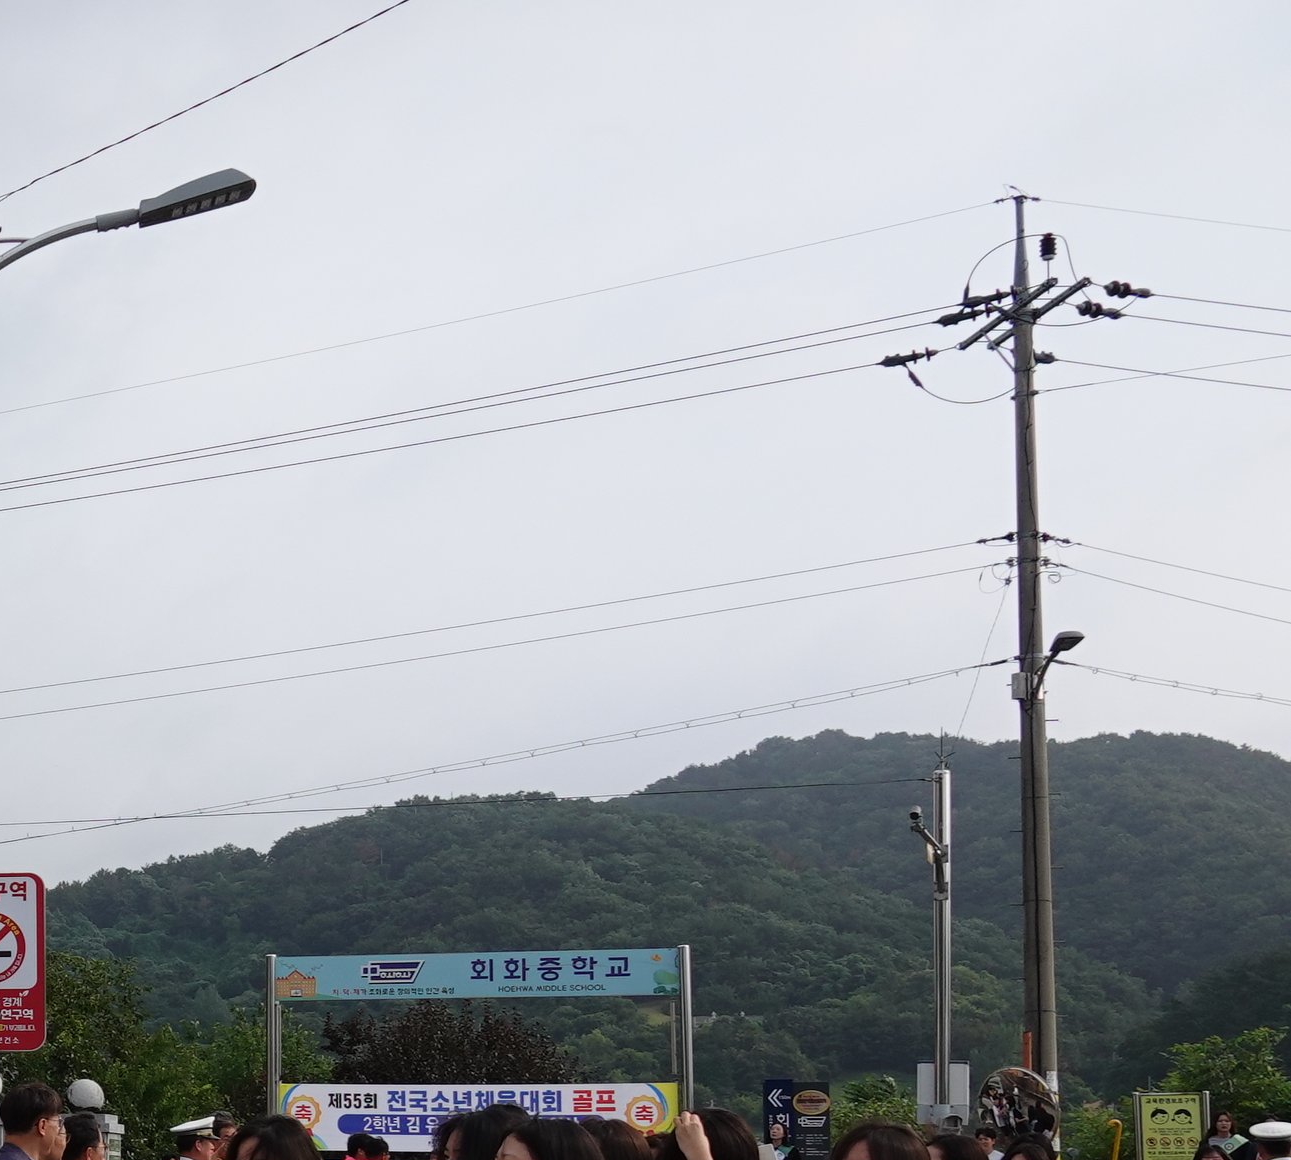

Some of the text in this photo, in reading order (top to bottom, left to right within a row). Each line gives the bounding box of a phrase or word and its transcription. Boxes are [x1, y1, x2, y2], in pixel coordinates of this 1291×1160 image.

[3, 918, 21, 936] Area
[470, 955, 631, 982] 회화중학교
[498, 985, 534, 993] HOEHWA
[569, 984, 606, 992] SCHOOL
[2, 997, 22, 1007] 경계
[328, 1092, 378, 1109] 제55회
[572, 1090, 616, 1112] 골프
[295, 1104, 312, 1122] 축
[635, 1105, 653, 1123] 축
[363, 1116, 401, 1133] 2학년
[406, 1116, 420, 1133] 김
